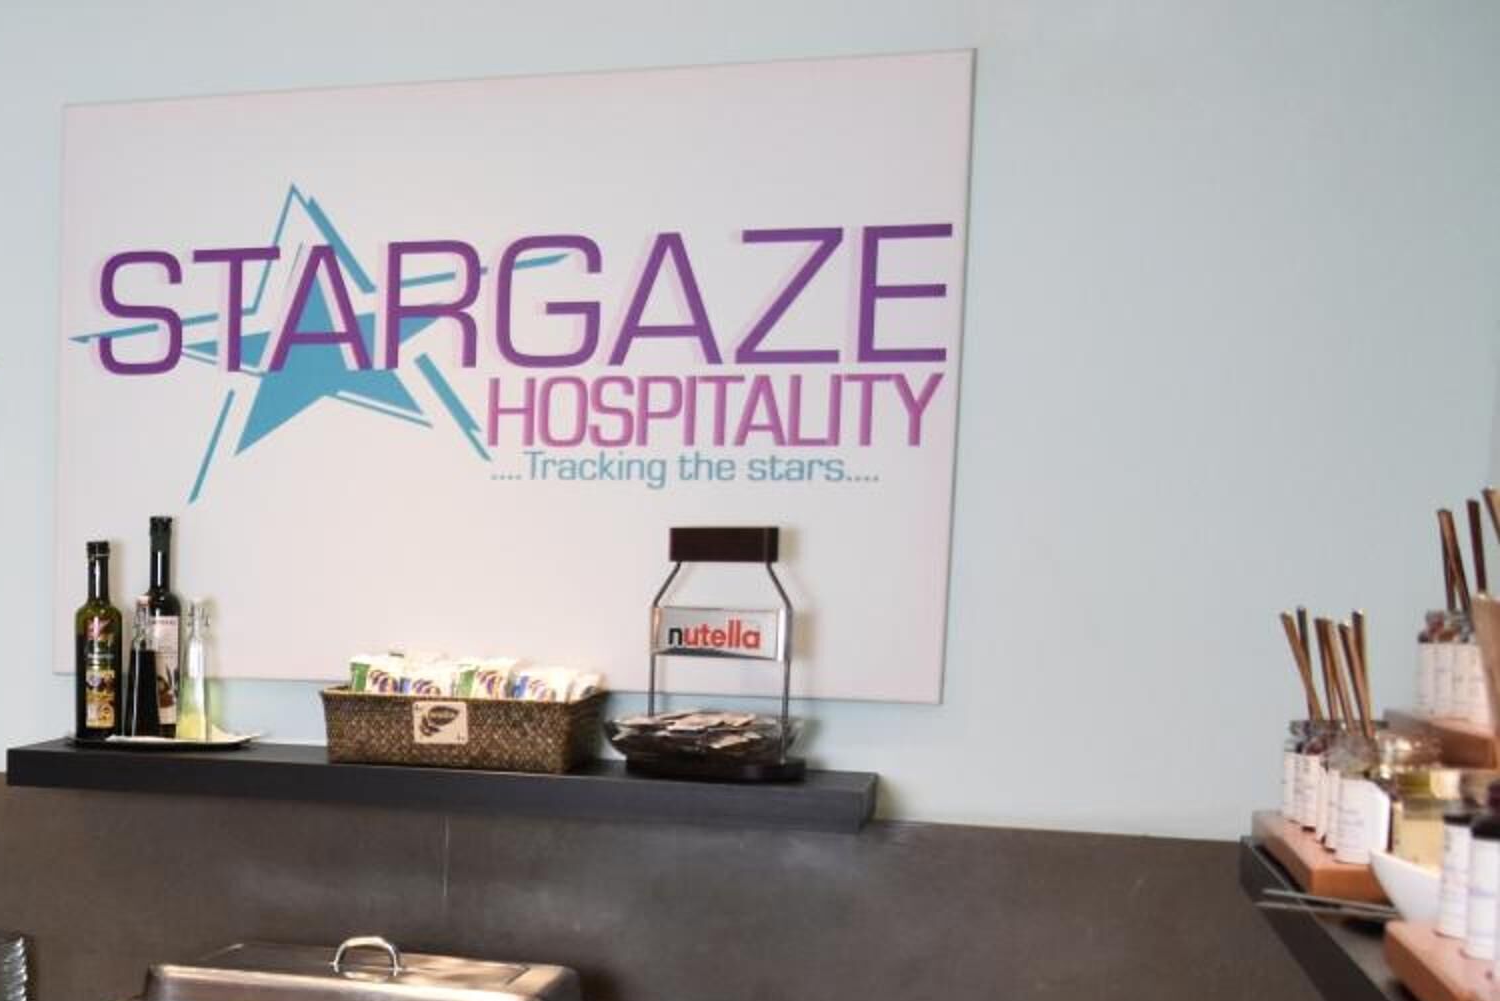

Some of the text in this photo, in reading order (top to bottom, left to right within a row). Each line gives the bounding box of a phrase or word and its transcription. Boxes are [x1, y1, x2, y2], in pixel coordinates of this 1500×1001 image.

[98, 223, 954, 376] STARGAZE
[486, 372, 944, 448] HOSPITALITY
[678, 451, 737, 482] the
[668, 618, 761, 649] nutella
